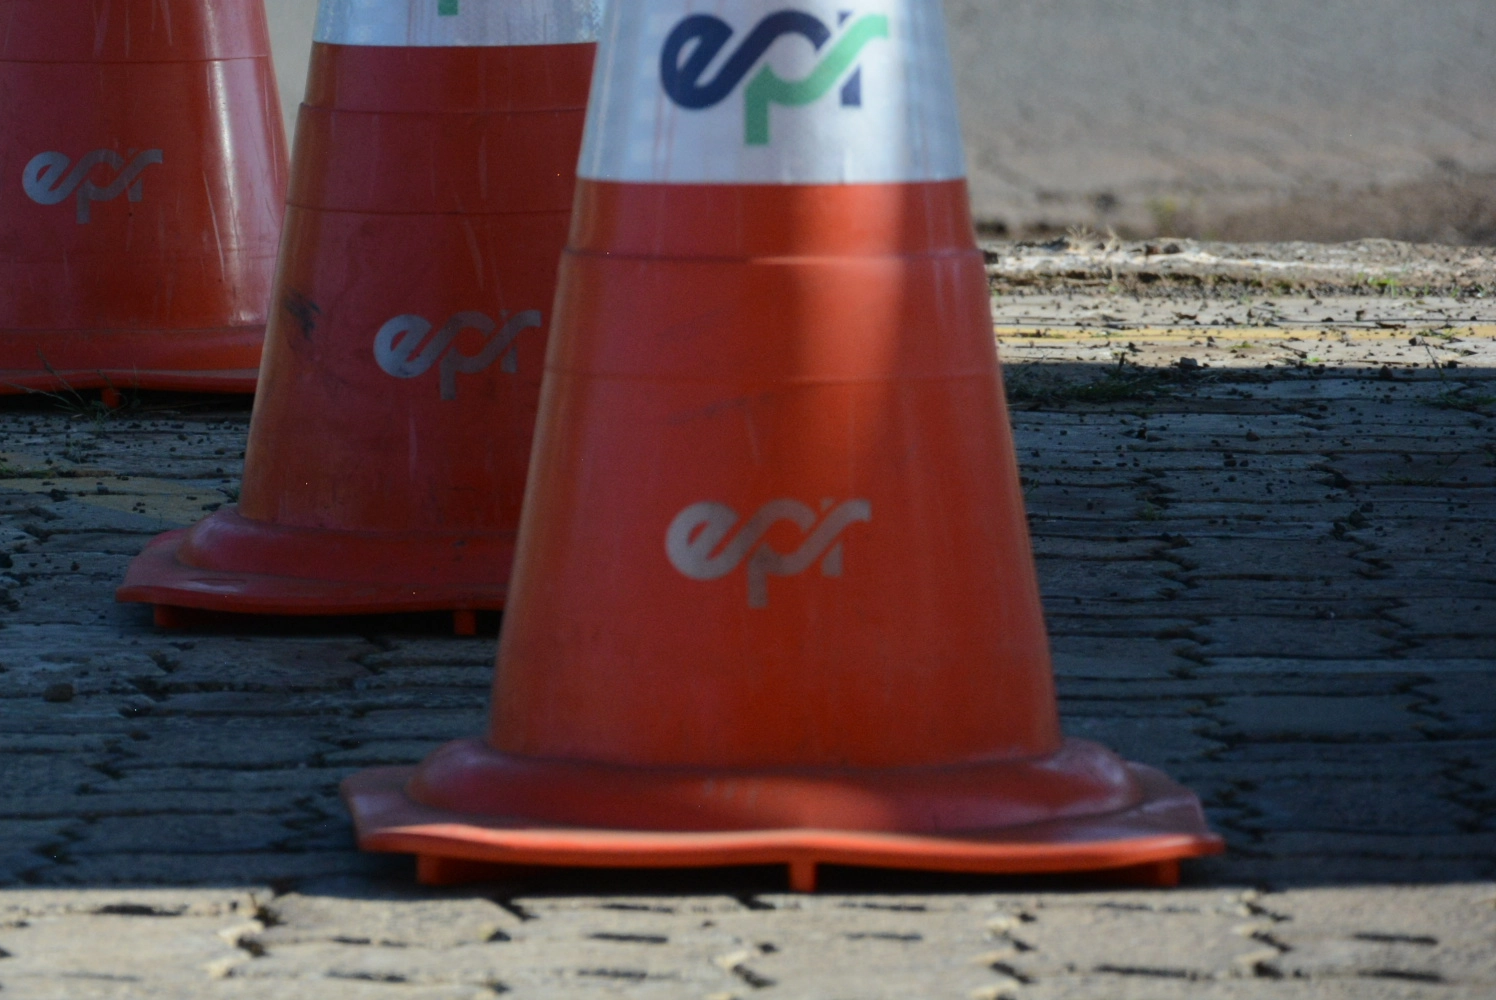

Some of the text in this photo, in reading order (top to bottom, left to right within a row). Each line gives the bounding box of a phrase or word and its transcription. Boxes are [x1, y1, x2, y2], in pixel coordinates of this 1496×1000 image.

[660, 9, 889, 145] epr
[22, 149, 163, 224] epr
[373, 310, 542, 400] epr
[665, 498, 872, 608] epr
